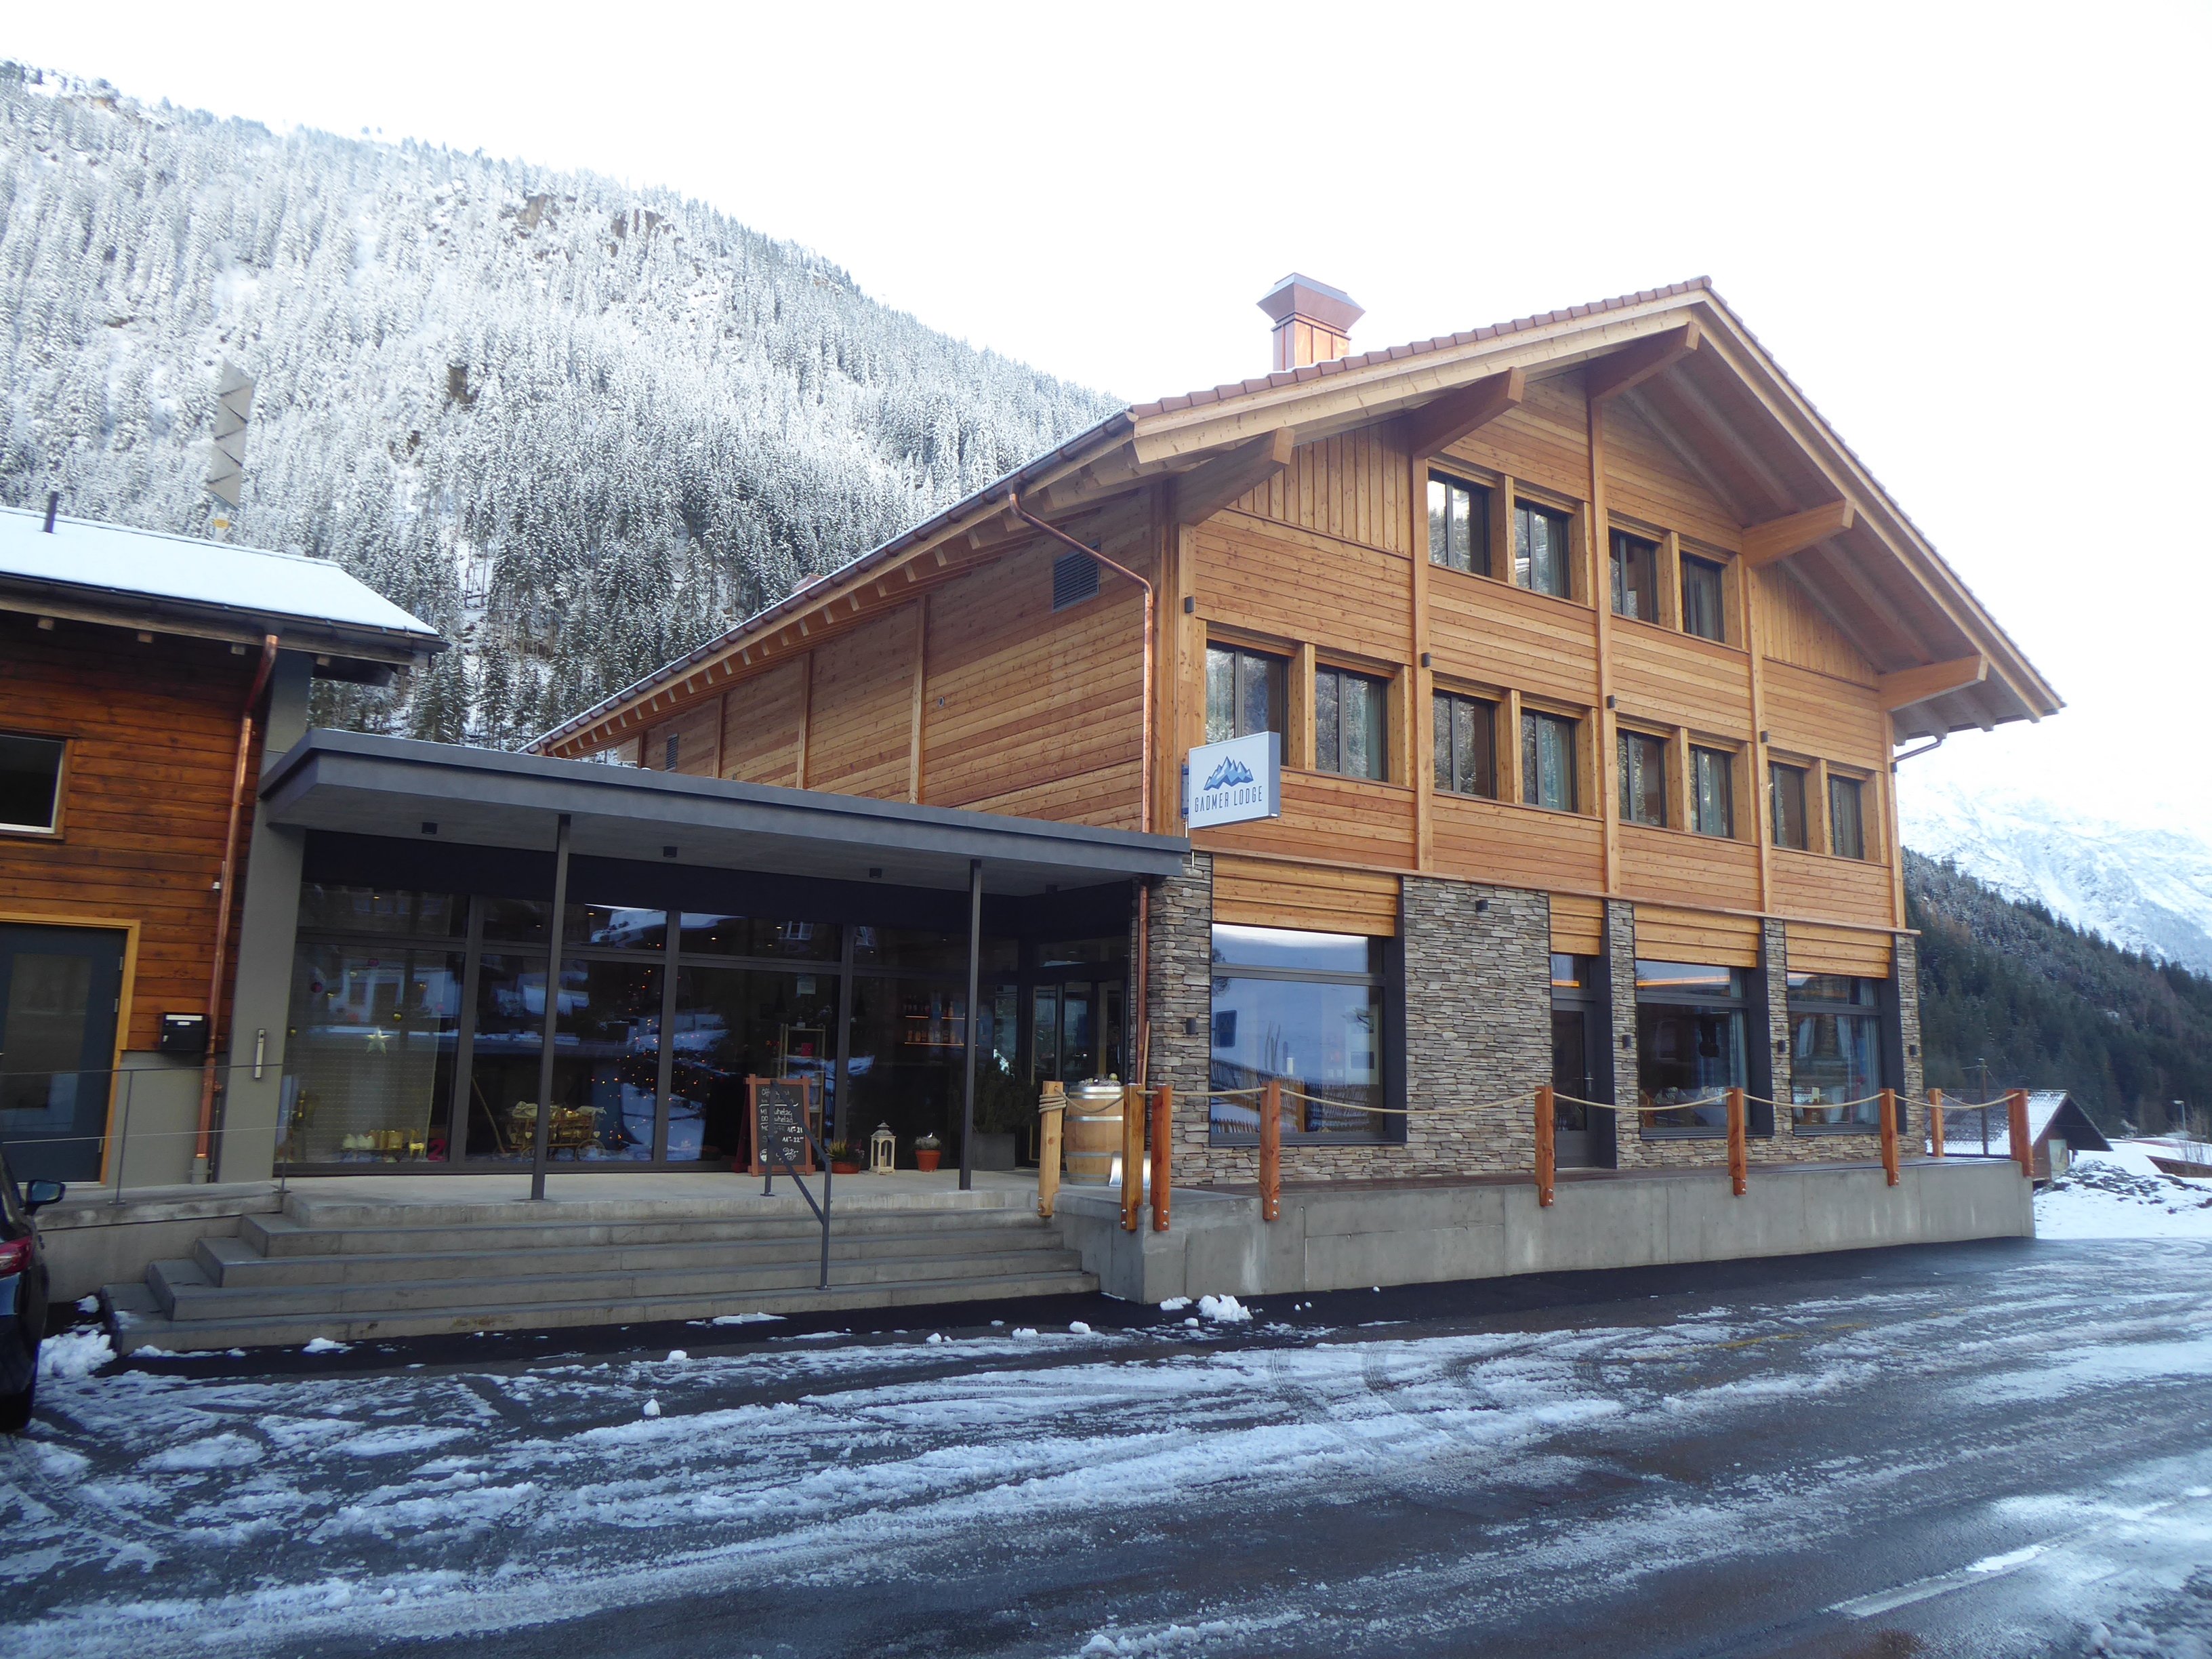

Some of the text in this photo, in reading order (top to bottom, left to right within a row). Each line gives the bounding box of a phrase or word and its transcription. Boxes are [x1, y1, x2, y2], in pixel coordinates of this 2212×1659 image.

[1194, 785, 1263, 813] GADMER LODGE
[774, 1108, 793, 1118] uhetag
[774, 1115, 794, 1124] uhetag
